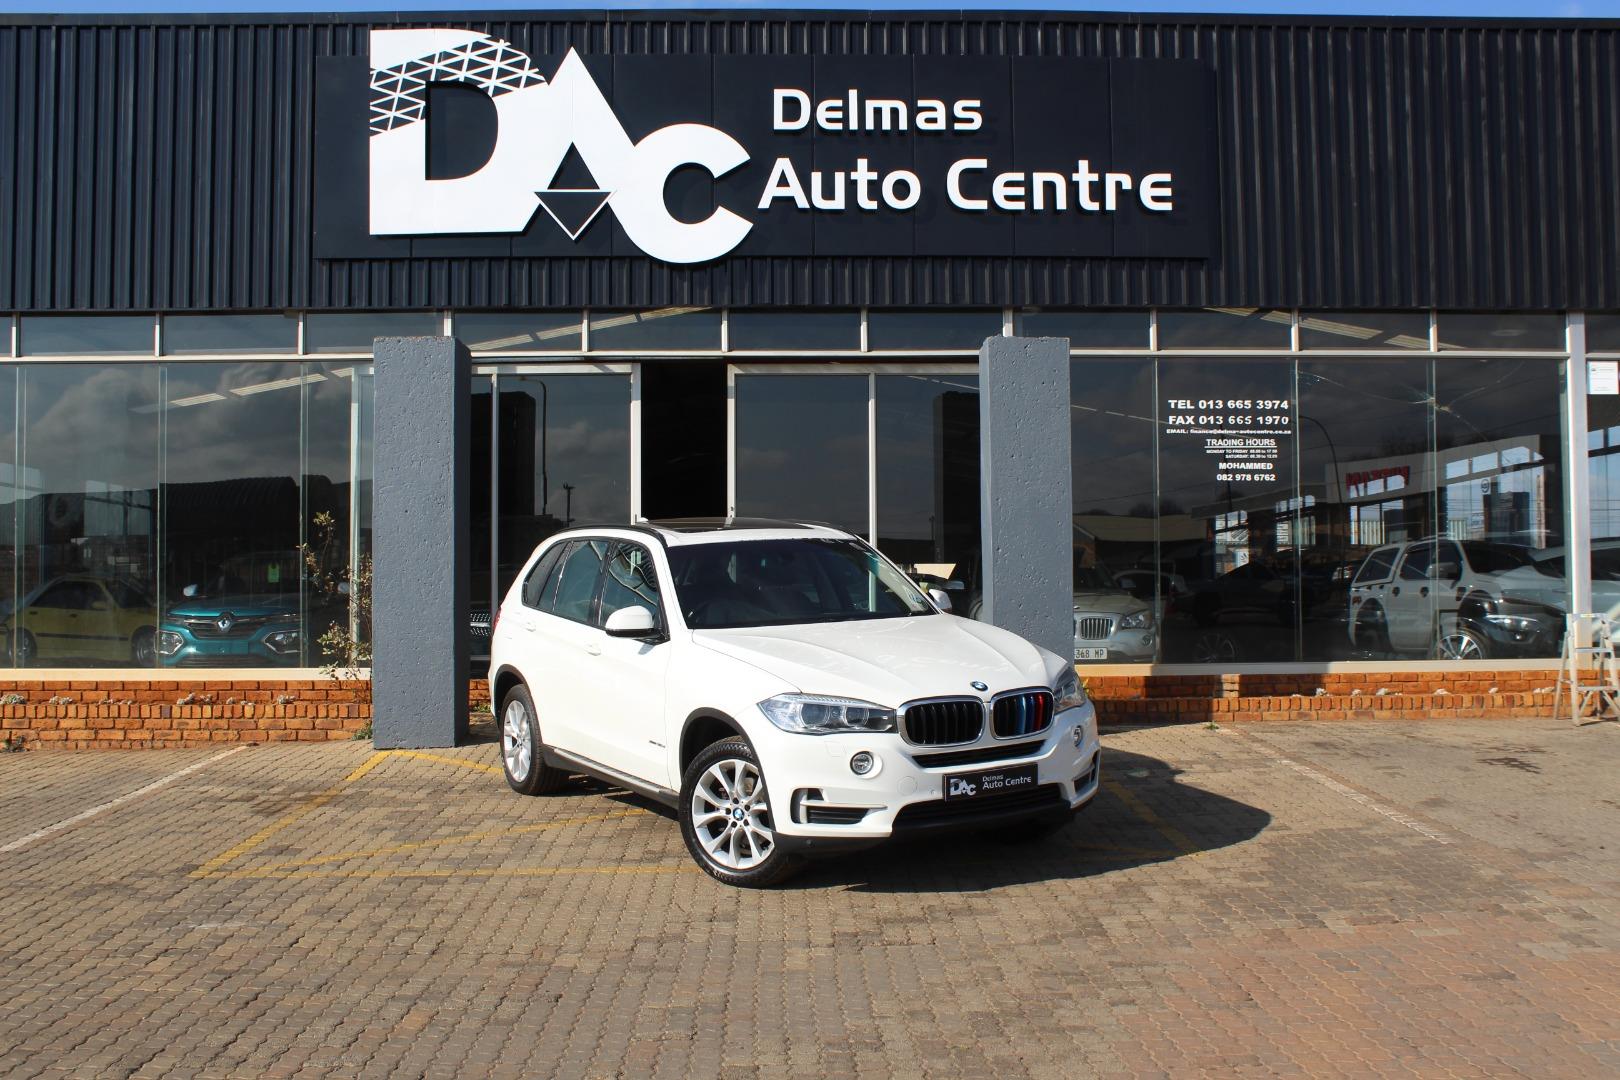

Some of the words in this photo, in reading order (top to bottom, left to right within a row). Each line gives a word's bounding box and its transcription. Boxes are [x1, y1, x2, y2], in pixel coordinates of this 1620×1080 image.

[773, 88, 983, 132] Delmas
[368, 28, 754, 265] DAC
[758, 157, 921, 211] Auto
[946, 158, 1174, 212] Centre
[1167, 399, 1195, 410] TEL
[1198, 399, 1224, 410] 013
[1227, 399, 1252, 410] 665
[1256, 399, 1289, 410] 3974
[1168, 415, 1196, 425] FAX
[1198, 415, 1224, 425] 013
[1228, 415, 1252, 425] 665
[1256, 415, 1289, 425] 1970
[1206, 438, 1244, 446] TRADING
[1246, 438, 1276, 446] HOURS
[1218, 462, 1274, 470] MOHAMMED
[1216, 473, 1233, 481] 082
[1235, 473, 1252, 481] 978
[1254, 473, 1276, 481] 6762
[982, 781, 1003, 790] Auto
[1005, 776, 1032, 786] Centre
